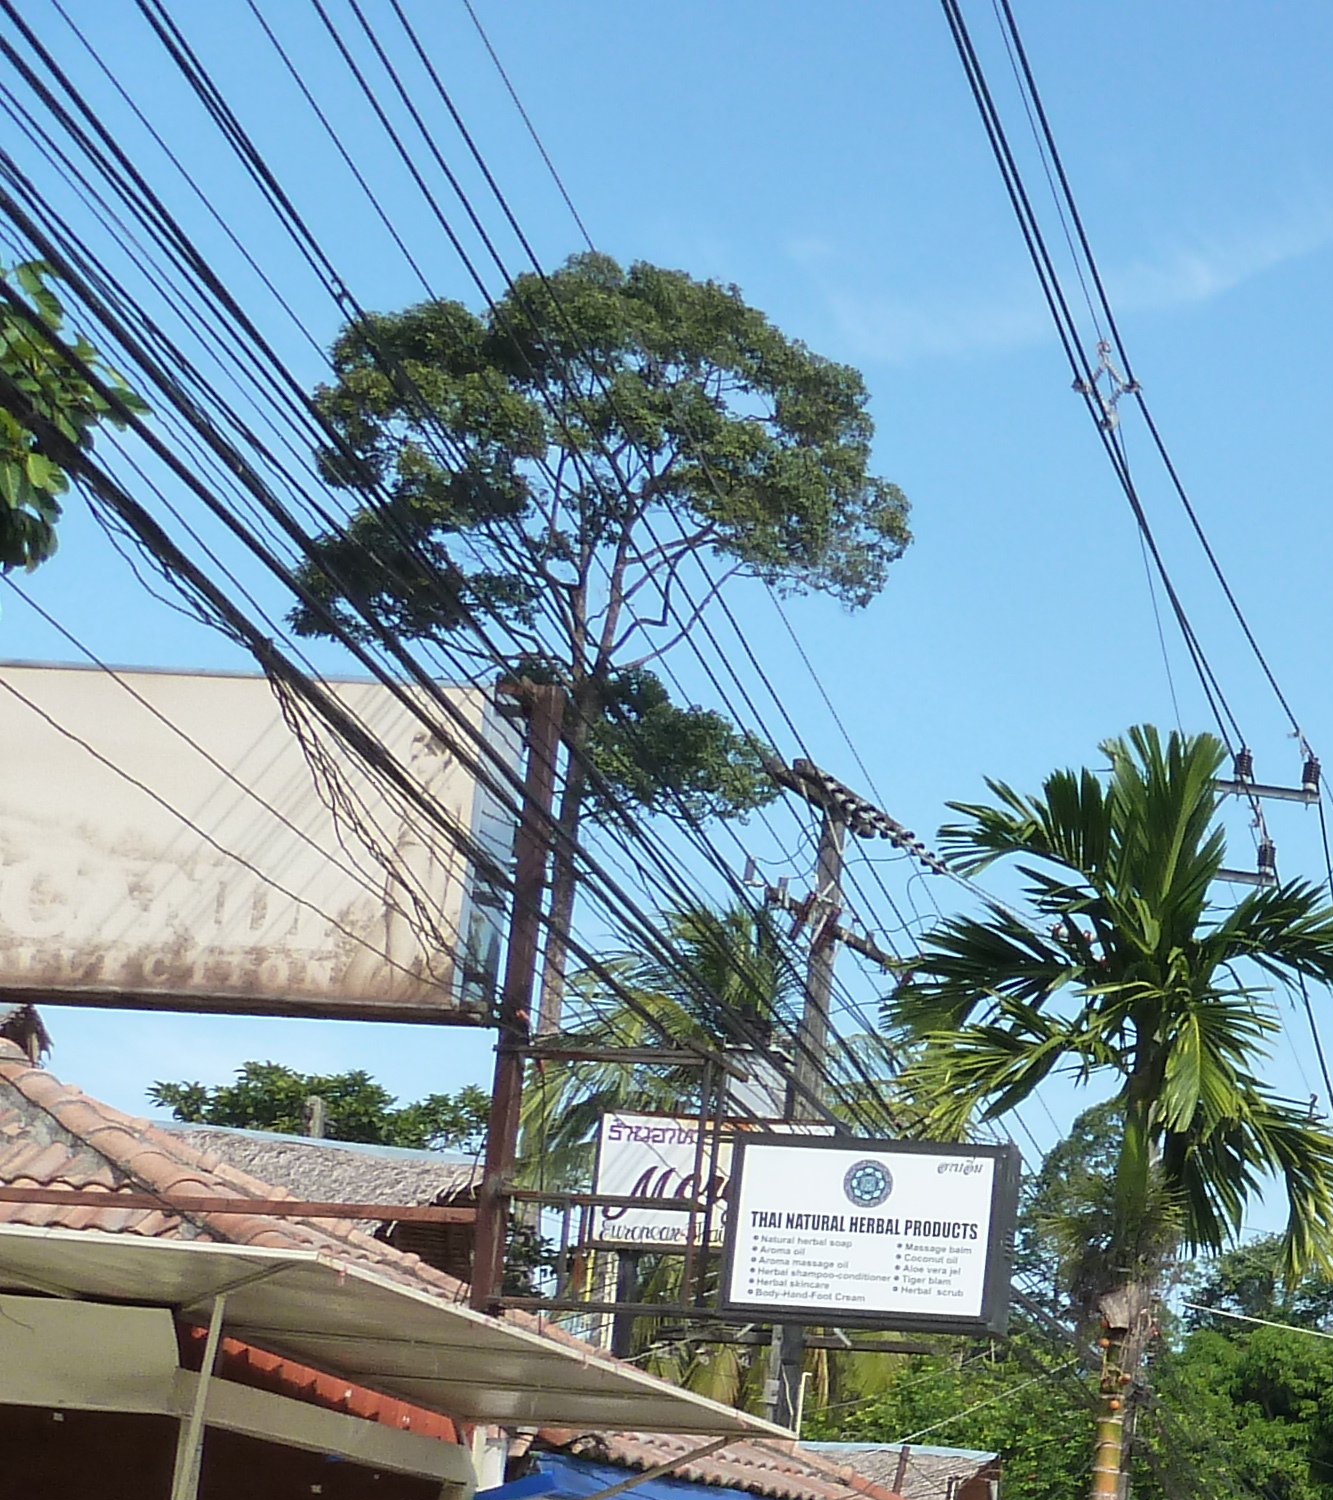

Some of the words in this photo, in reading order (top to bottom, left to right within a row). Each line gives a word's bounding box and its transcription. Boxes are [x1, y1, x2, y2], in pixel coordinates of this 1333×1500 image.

[751, 1211, 782, 1228] THAI
[786, 1213, 845, 1232] NATURAL
[849, 1217, 900, 1235] HERBAL
[904, 1220, 978, 1239] PRODUCTS
[761, 1235, 794, 1244] Natural
[797, 1237, 827, 1246] herbal
[829, 1239, 852, 1248] soap
[760, 1246, 791, 1255] Aroma
[905, 1243, 946, 1254] Massage
[758, 1256, 790, 1265] Aroma
[792, 1259, 834, 1269] massage
[904, 1254, 944, 1263] Coconut
[946, 1256, 958, 1264] oil
[757, 1267, 788, 1276] Herbal
[791, 1269, 890, 1282] shampoo-conditioner
[903, 1264, 924, 1273] Aloe
[949, 1267, 961, 1277] jel
[756, 1277, 787, 1287] Herbal
[789, 1279, 830, 1289] skincare
[902, 1275, 926, 1285] Tiger
[755, 1288, 832, 1300] Body-Hand-Foot
[835, 1292, 865, 1302] Cream
[901, 1286, 931, 1295] Herbal
[937, 1288, 963, 1297] scrub
